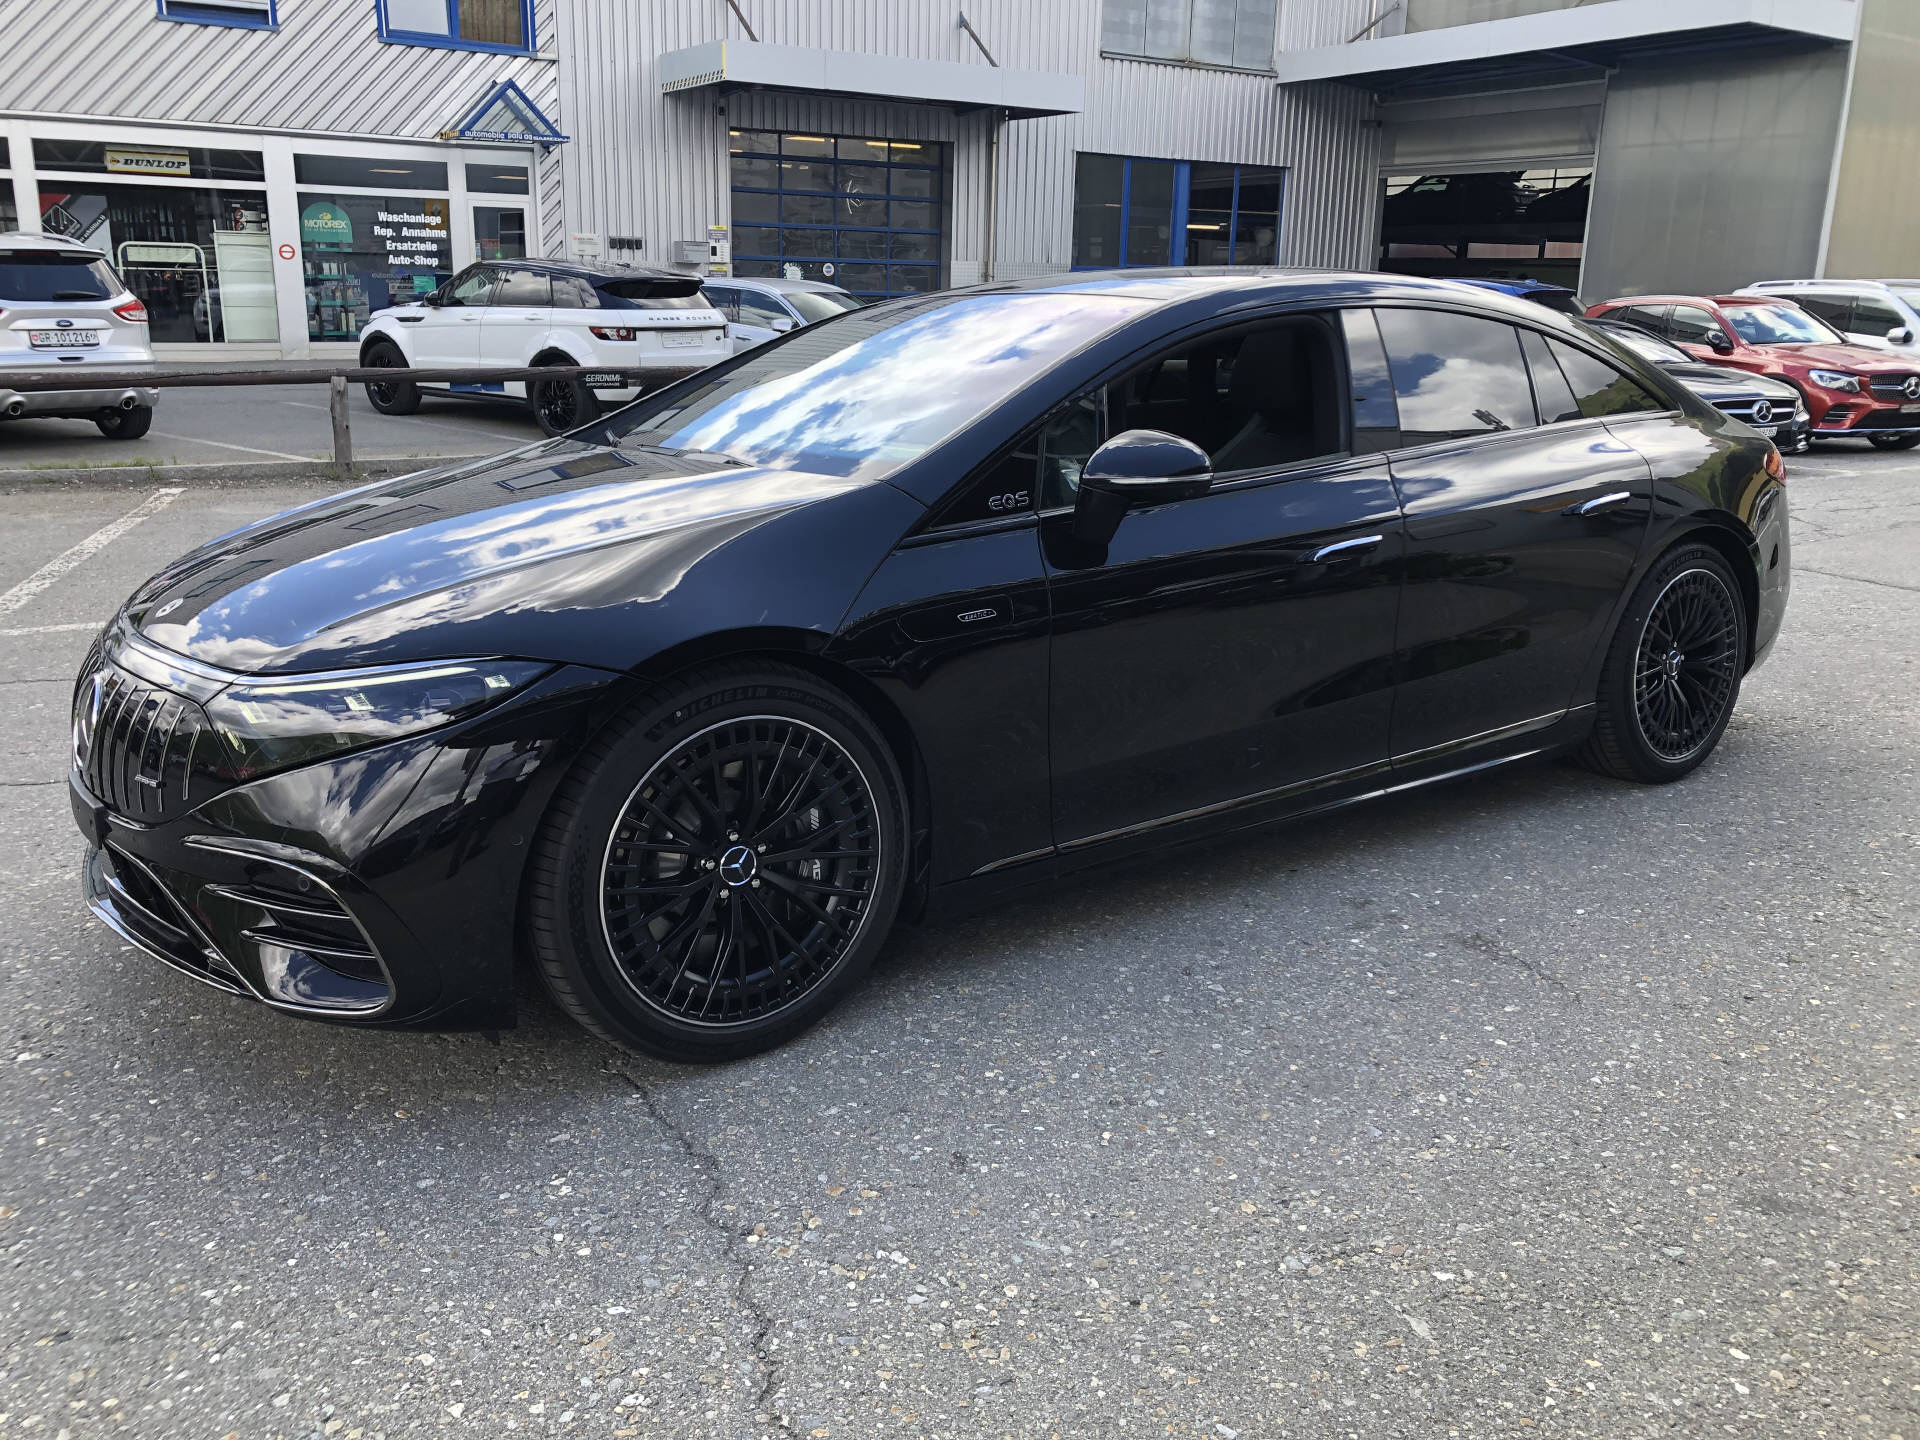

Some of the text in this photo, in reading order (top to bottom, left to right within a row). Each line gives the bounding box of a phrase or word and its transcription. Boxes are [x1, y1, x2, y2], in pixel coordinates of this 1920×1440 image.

[464, 130, 505, 139] automobile
[123, 158, 187, 169] DUNLOP
[304, 219, 347, 229] MOTOREX
[377, 211, 442, 226] Waschanlage
[373, 225, 447, 238] Rep. Annahme
[386, 240, 438, 252] Ersatzteile
[387, 254, 439, 268] Auto-Shop
[988, 490, 1030, 511] EQS
